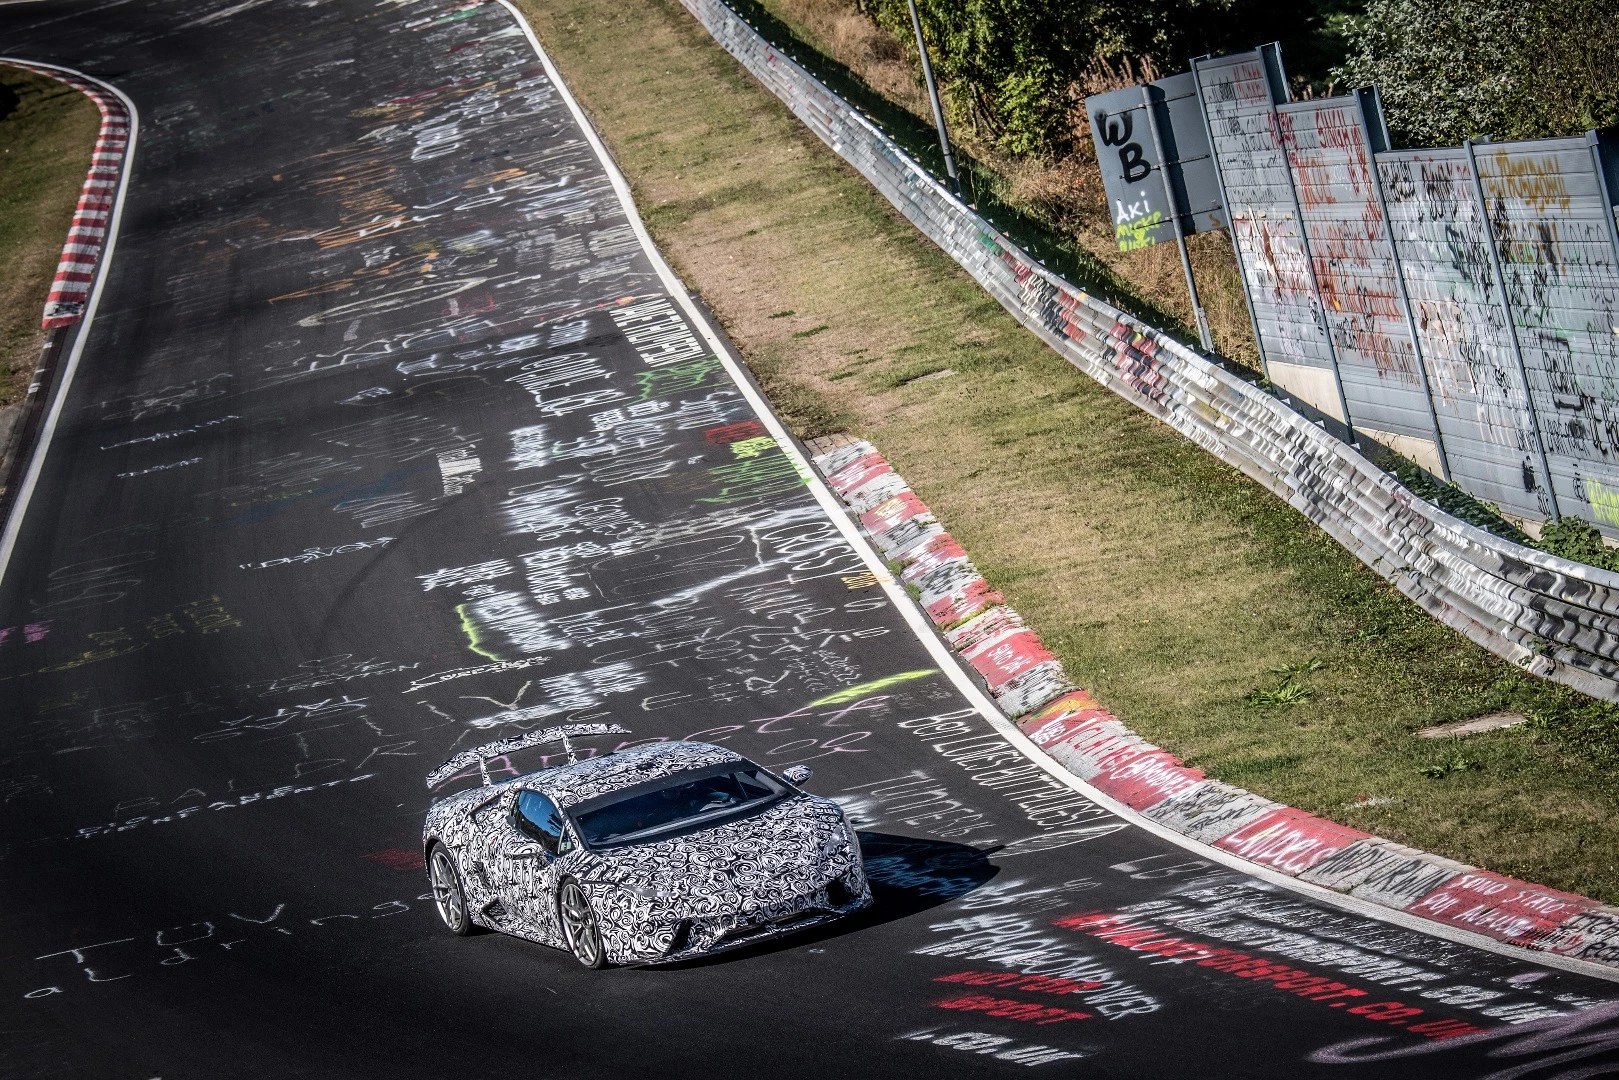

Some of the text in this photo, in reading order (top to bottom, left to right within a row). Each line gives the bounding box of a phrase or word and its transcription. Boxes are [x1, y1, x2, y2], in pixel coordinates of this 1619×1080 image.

[1095, 107, 1133, 147] W
[1119, 142, 1151, 184] B
[933, 732, 1026, 771] LOVES
[1448, 874, 1565, 914] SONO STATO
